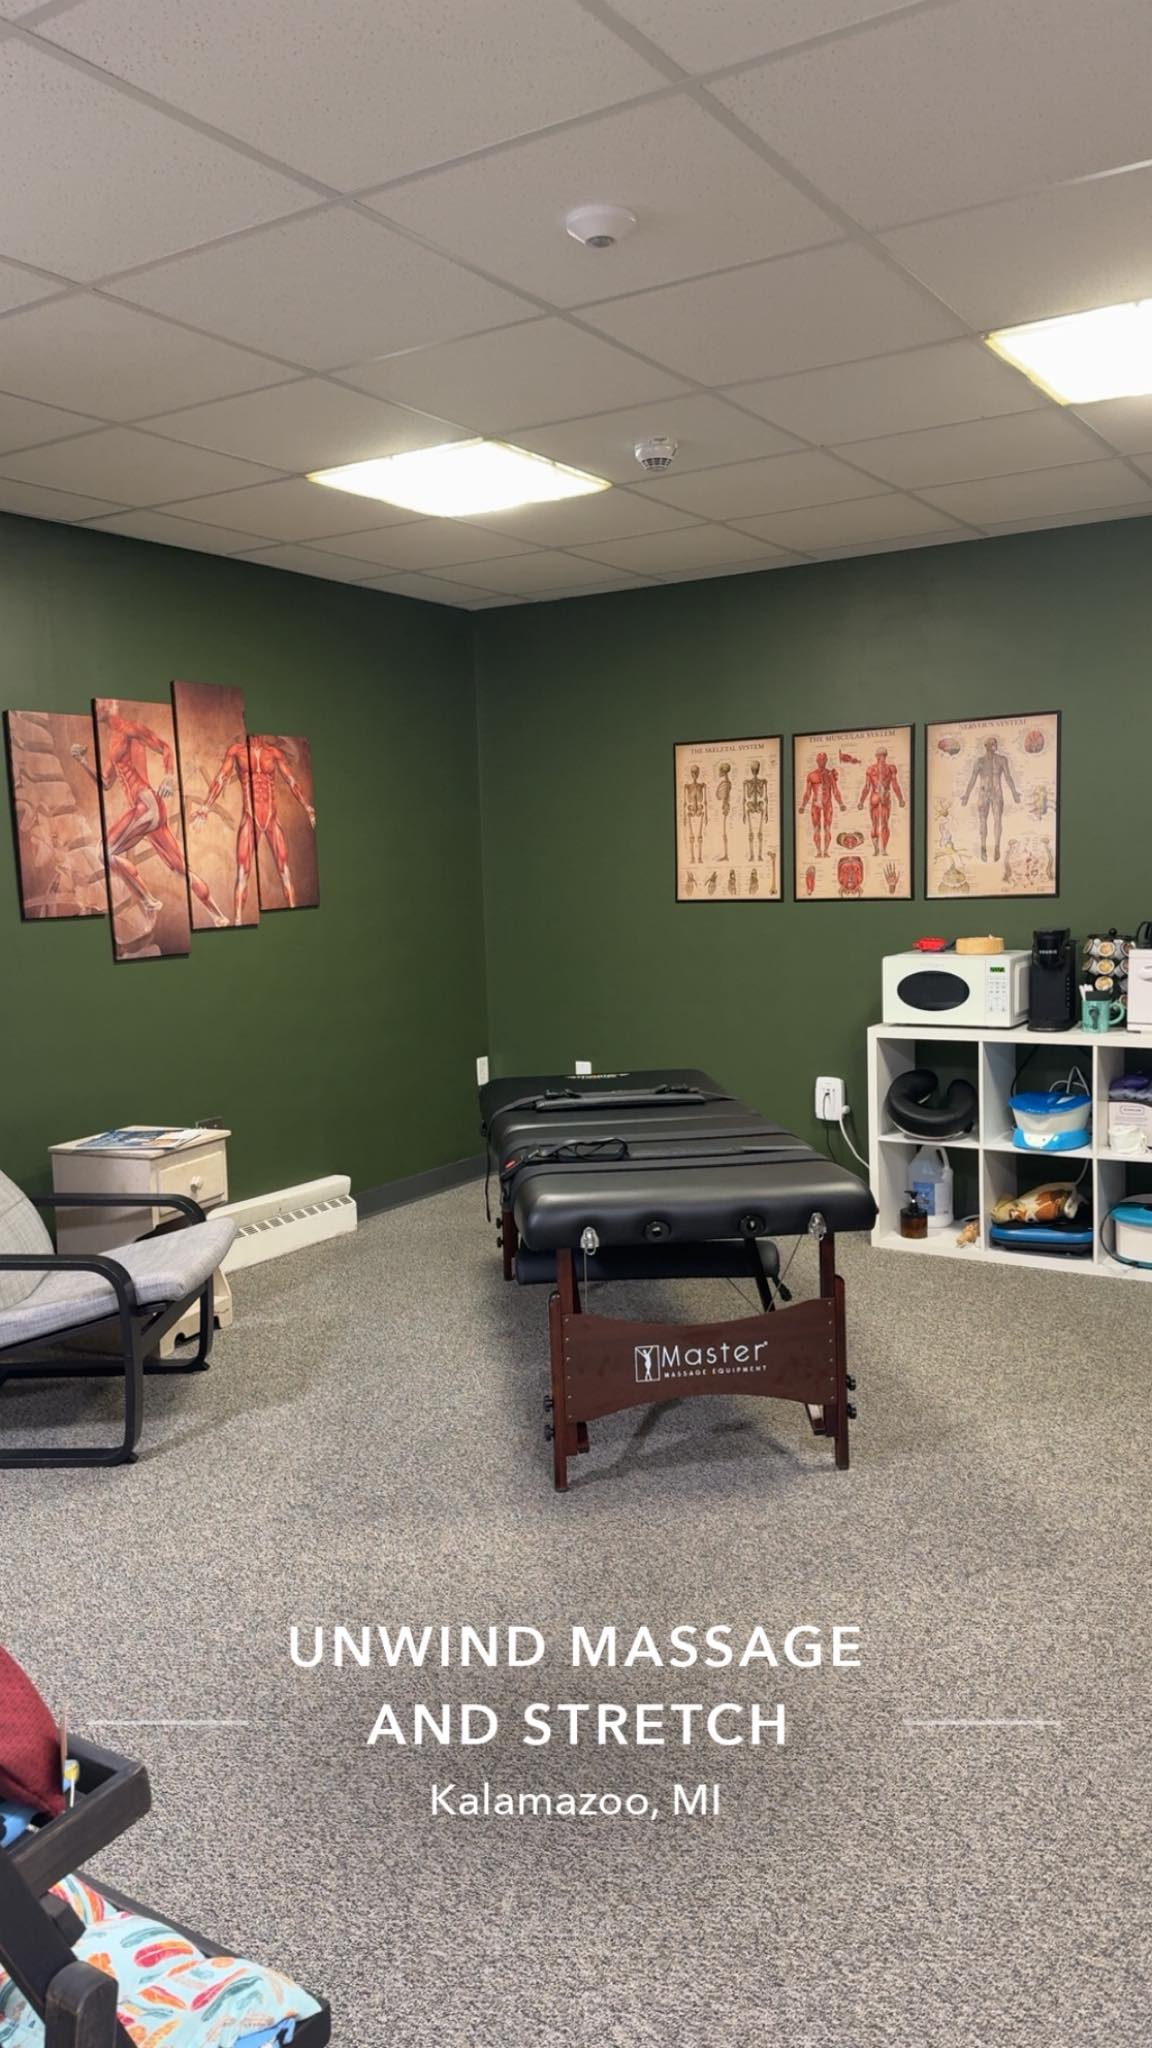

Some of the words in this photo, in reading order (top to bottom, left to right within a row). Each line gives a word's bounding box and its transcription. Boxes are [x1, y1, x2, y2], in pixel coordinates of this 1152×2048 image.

[996, 719, 1026, 727] SYSTEM
[825, 733, 864, 742] MUSCULAR
[866, 730, 896, 738] SYSTEM
[705, 745, 735, 753] SKELETAL
[738, 743, 765, 751] SYSTEM
[662, 1340, 768, 1367] Master
[664, 1370, 707, 1378] MASSAGE
[712, 1365, 767, 1375] EQUIPMENT
